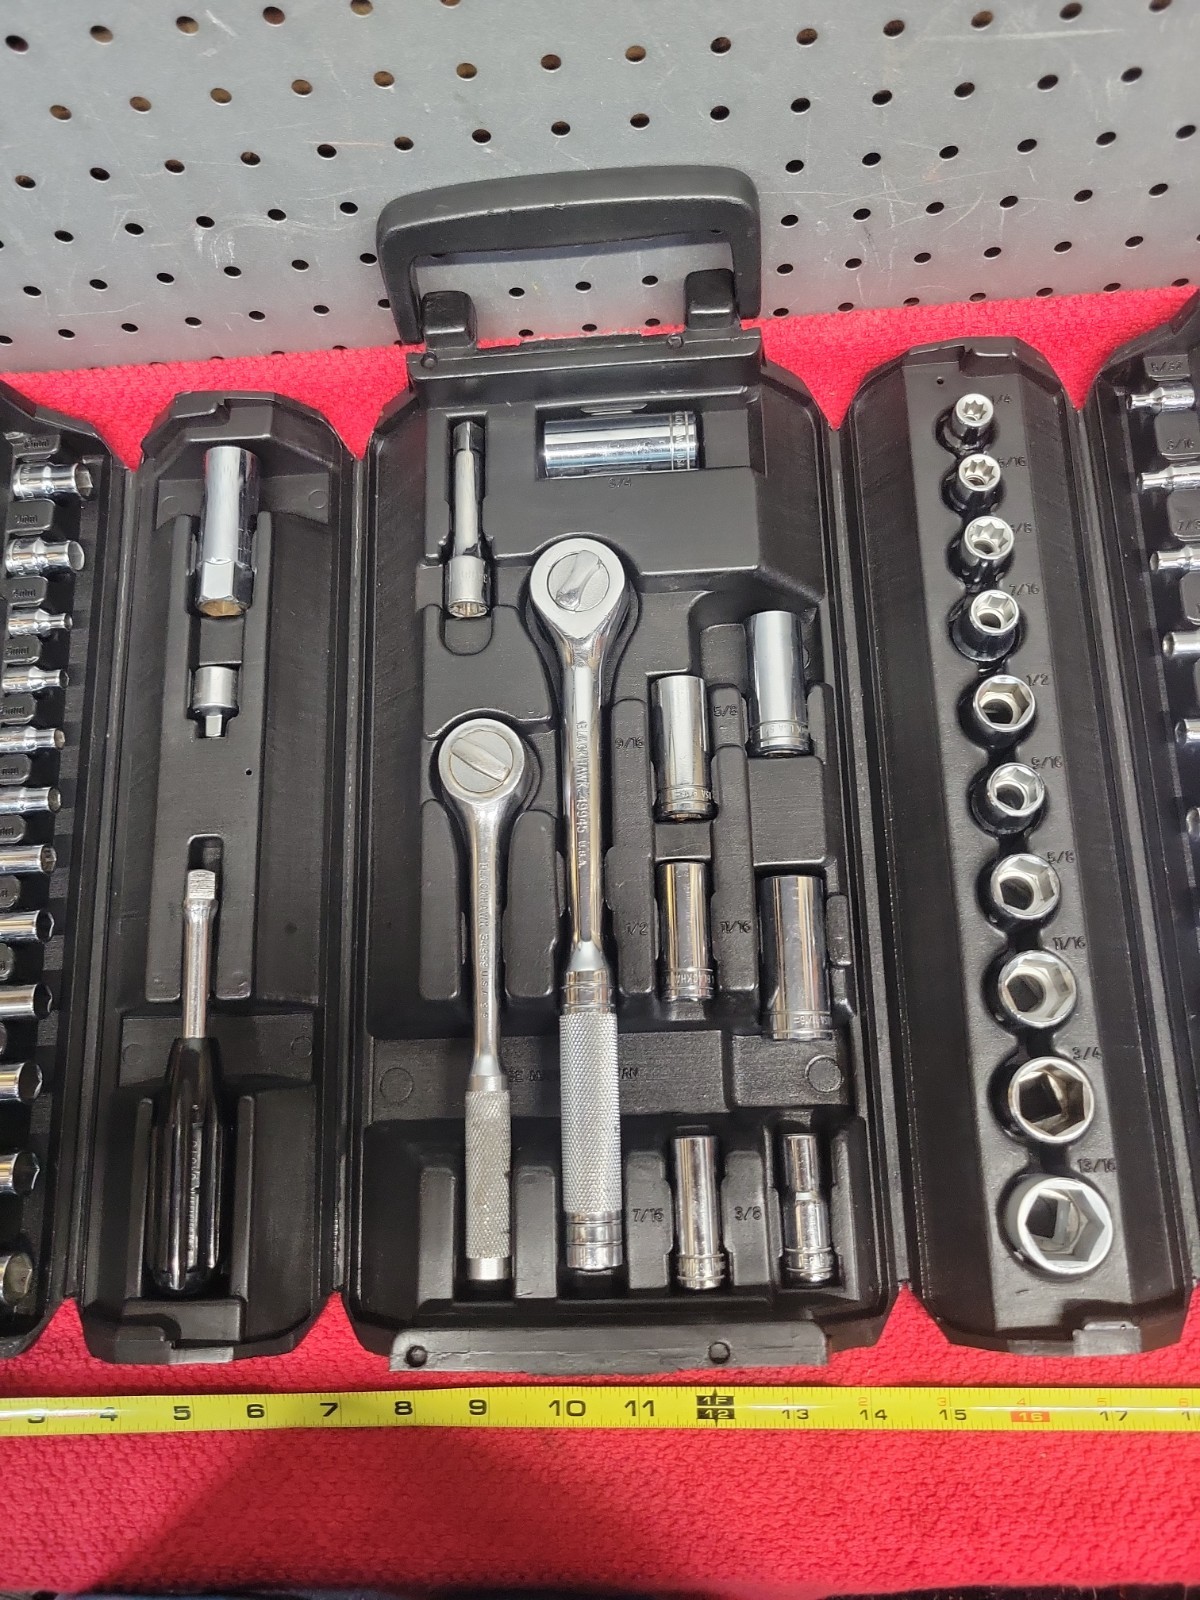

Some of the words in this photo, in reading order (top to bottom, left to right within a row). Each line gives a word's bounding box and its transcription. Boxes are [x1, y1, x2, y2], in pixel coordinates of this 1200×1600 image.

[1009, 583, 1040, 596] 7/16
[1026, 673, 1049, 687] 1/2
[713, 705, 738, 717] 5/8
[614, 737, 644, 749] 9/16
[1031, 756, 1063, 770] 9/16
[1047, 851, 1075, 864] 5/8
[626, 922, 648, 935] 1/2
[720, 921, 751, 933] 11/16
[1052, 936, 1086, 950] 11/16
[1072, 1046, 1101, 1061] 3/4
[1077, 1158, 1117, 1173] 13/16
[633, 1208, 664, 1222] 7/16
[734, 1206, 762, 1221] 3/8
[99, 1406, 118, 1422] 4
[173, 1405, 191, 1421] 5
[246, 1404, 265, 1418] 6
[319, 1402, 339, 1417] 7
[394, 1400, 413, 1416] 8
[468, 1399, 488, 1415] 9
[549, 1399, 586, 1417] 10
[624, 1399, 655, 1417] 11
[704, 1409, 730, 1419] 12
[781, 1408, 809, 1420] 13
[859, 1409, 888, 1421] 14
[938, 1409, 967, 1421] 15
[1018, 1412, 1044, 1422] 16
[1099, 1410, 1128, 1421] 17
